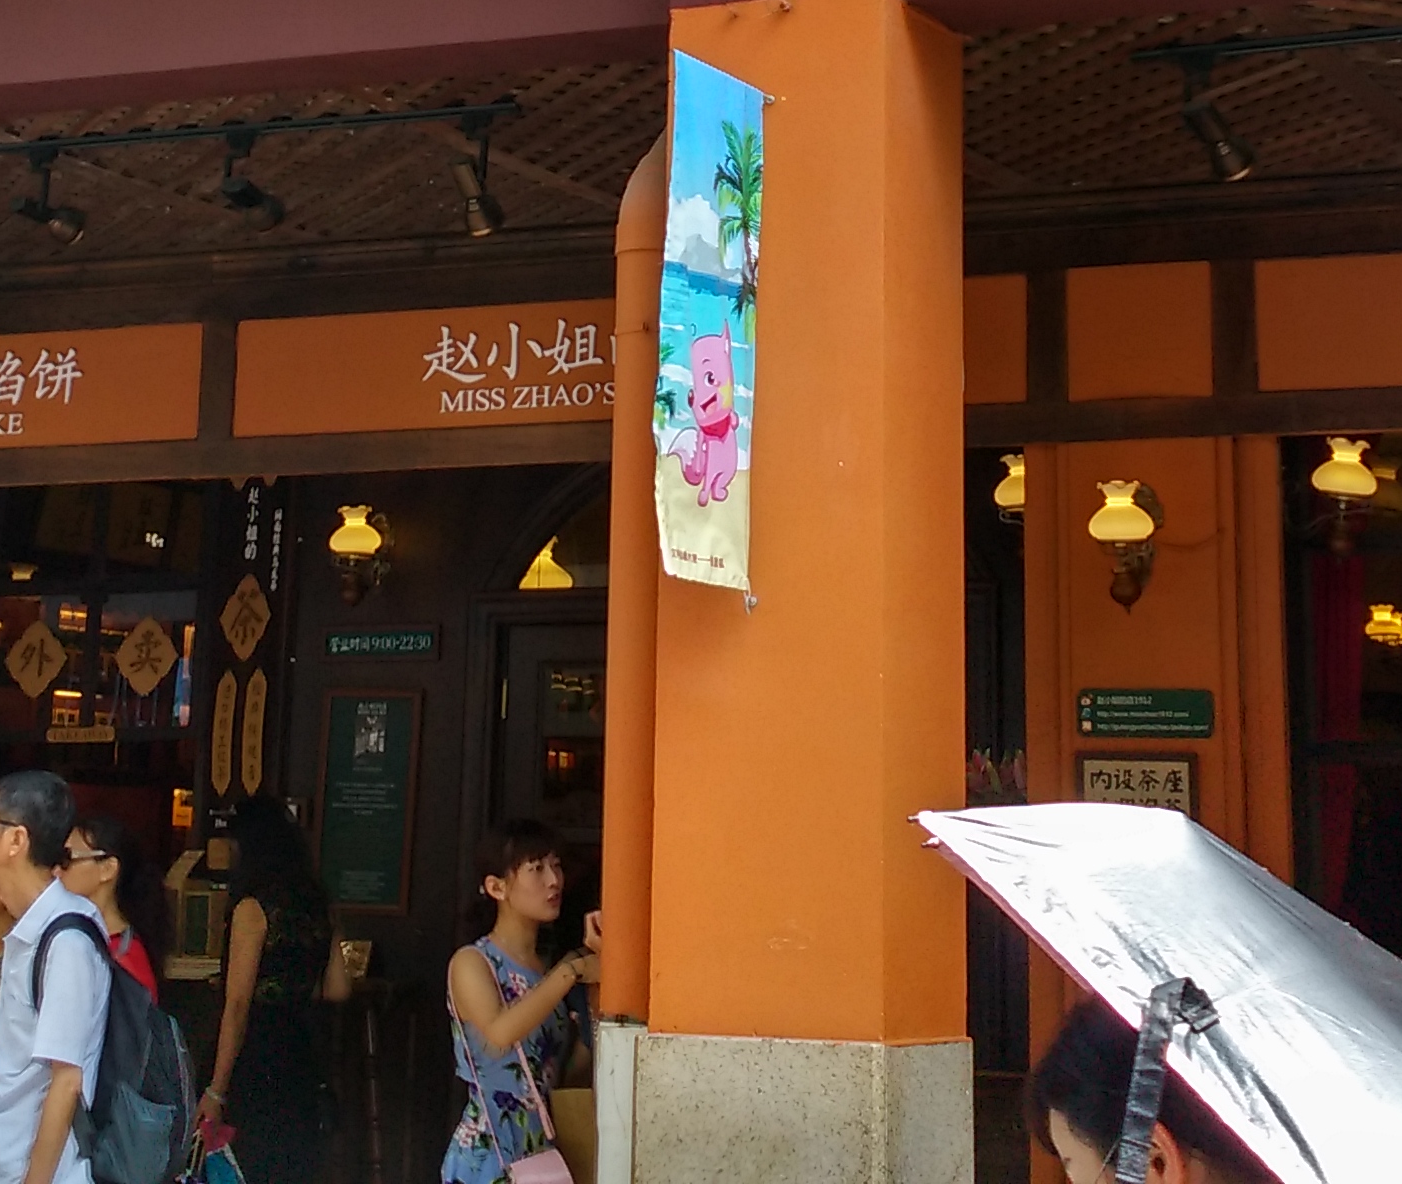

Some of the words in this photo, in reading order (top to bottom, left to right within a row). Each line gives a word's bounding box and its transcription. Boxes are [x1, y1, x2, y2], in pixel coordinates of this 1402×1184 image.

[422, 318, 615, 383] 赵小姐
[440, 388, 506, 413] MISS
[229, 587, 266, 646] 茶
[1089, 768, 1185, 793] 内设茶座
